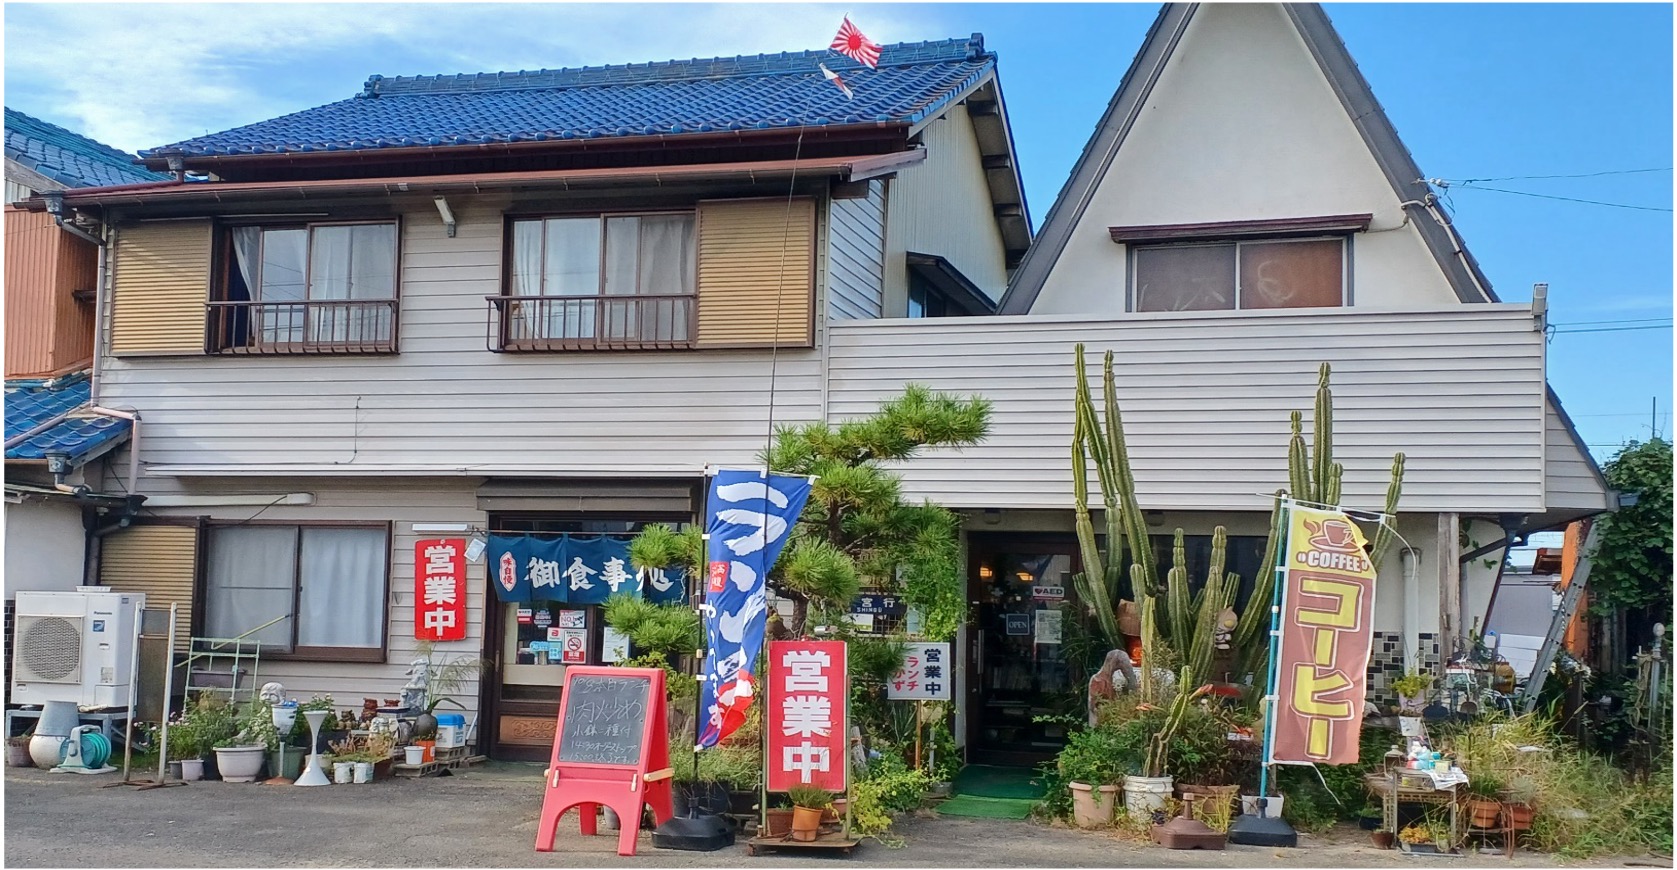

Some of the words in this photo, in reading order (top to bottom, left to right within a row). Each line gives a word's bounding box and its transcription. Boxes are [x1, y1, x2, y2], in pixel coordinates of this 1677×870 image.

[502, 557, 514, 585] 味自慢
[1307, 550, 1361, 572] COFFEE
[424, 545, 457, 636] 営業中
[1008, 621, 1027, 629] OPEN
[907, 656, 919, 691] ランチ
[924, 648, 942, 695] 営業中
[1292, 576, 1363, 759] コーヒー
[782, 650, 832, 783] 営業中
